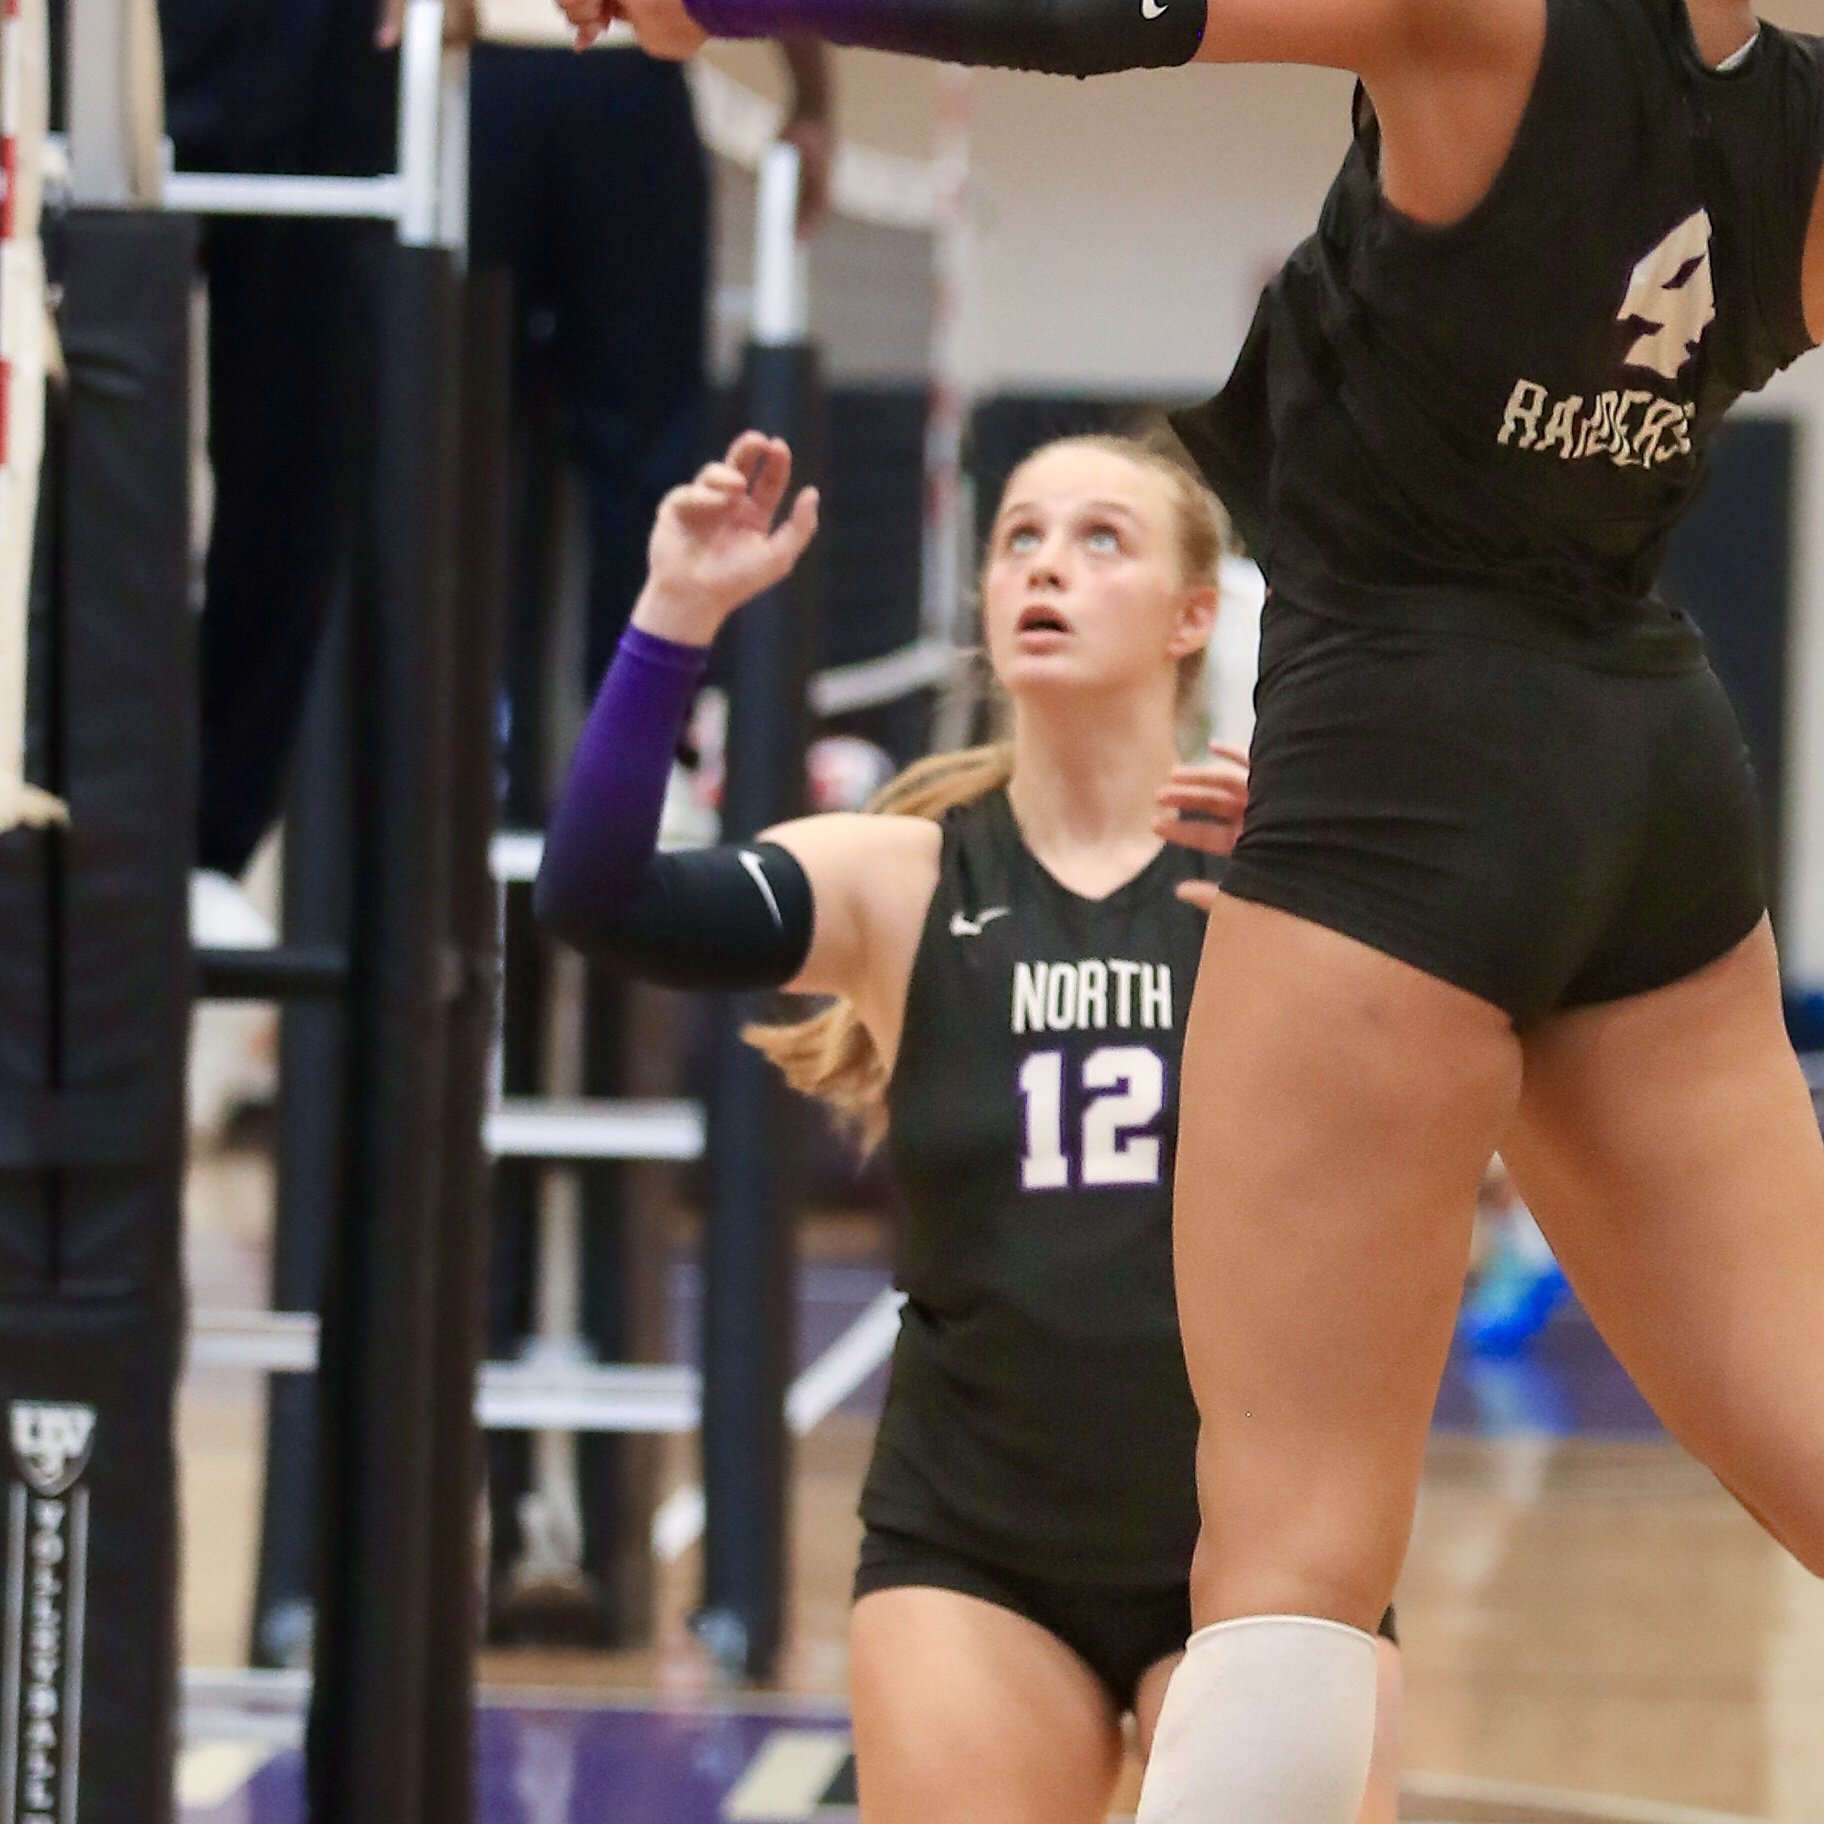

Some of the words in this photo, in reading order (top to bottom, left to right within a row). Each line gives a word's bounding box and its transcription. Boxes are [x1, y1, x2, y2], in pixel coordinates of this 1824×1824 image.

[1616, 206, 1717, 379] 4
[1011, 956, 1173, 1034] NORTH
[1016, 1044, 1166, 1192] 12
